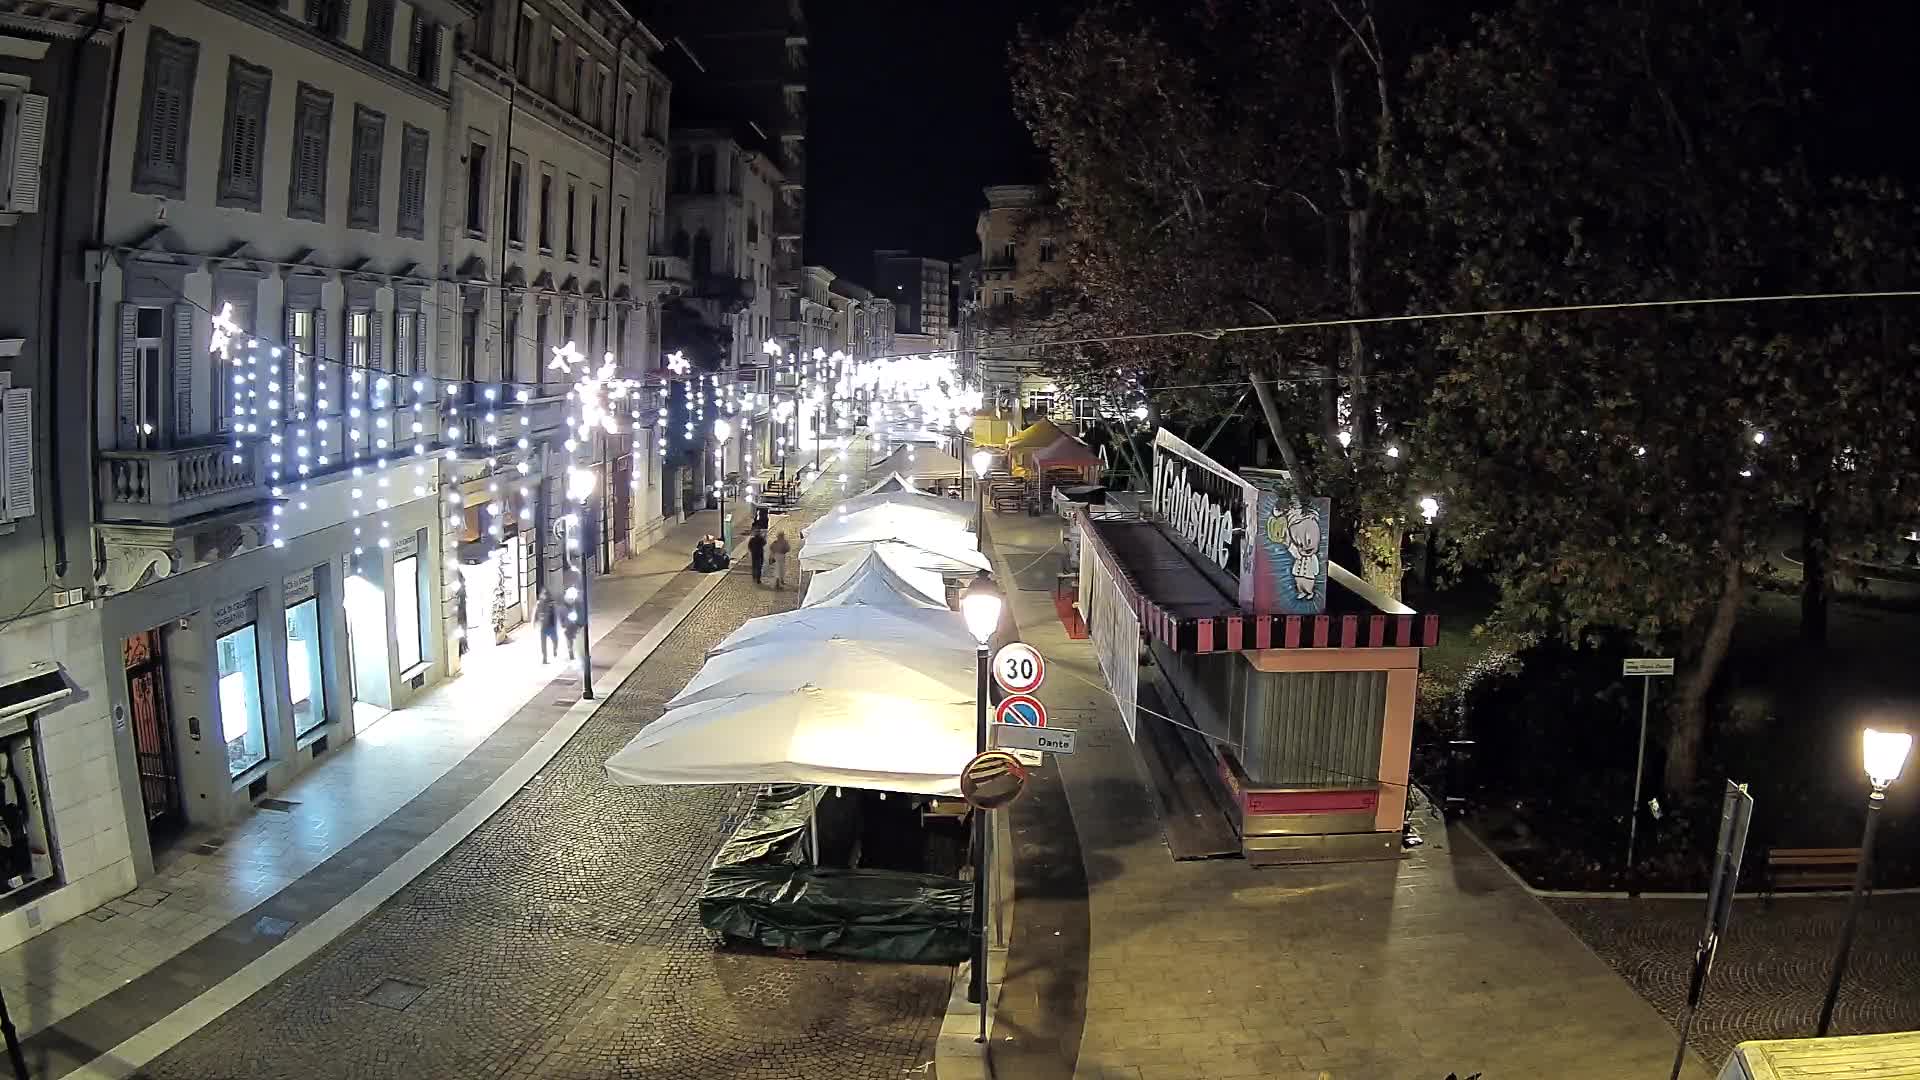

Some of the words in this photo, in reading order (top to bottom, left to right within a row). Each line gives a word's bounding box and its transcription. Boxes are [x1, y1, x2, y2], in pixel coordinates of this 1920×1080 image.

[1162, 458, 1233, 570] Golosone
[1006, 659, 1033, 679] 30
[1038, 737, 1069, 749] Dante
